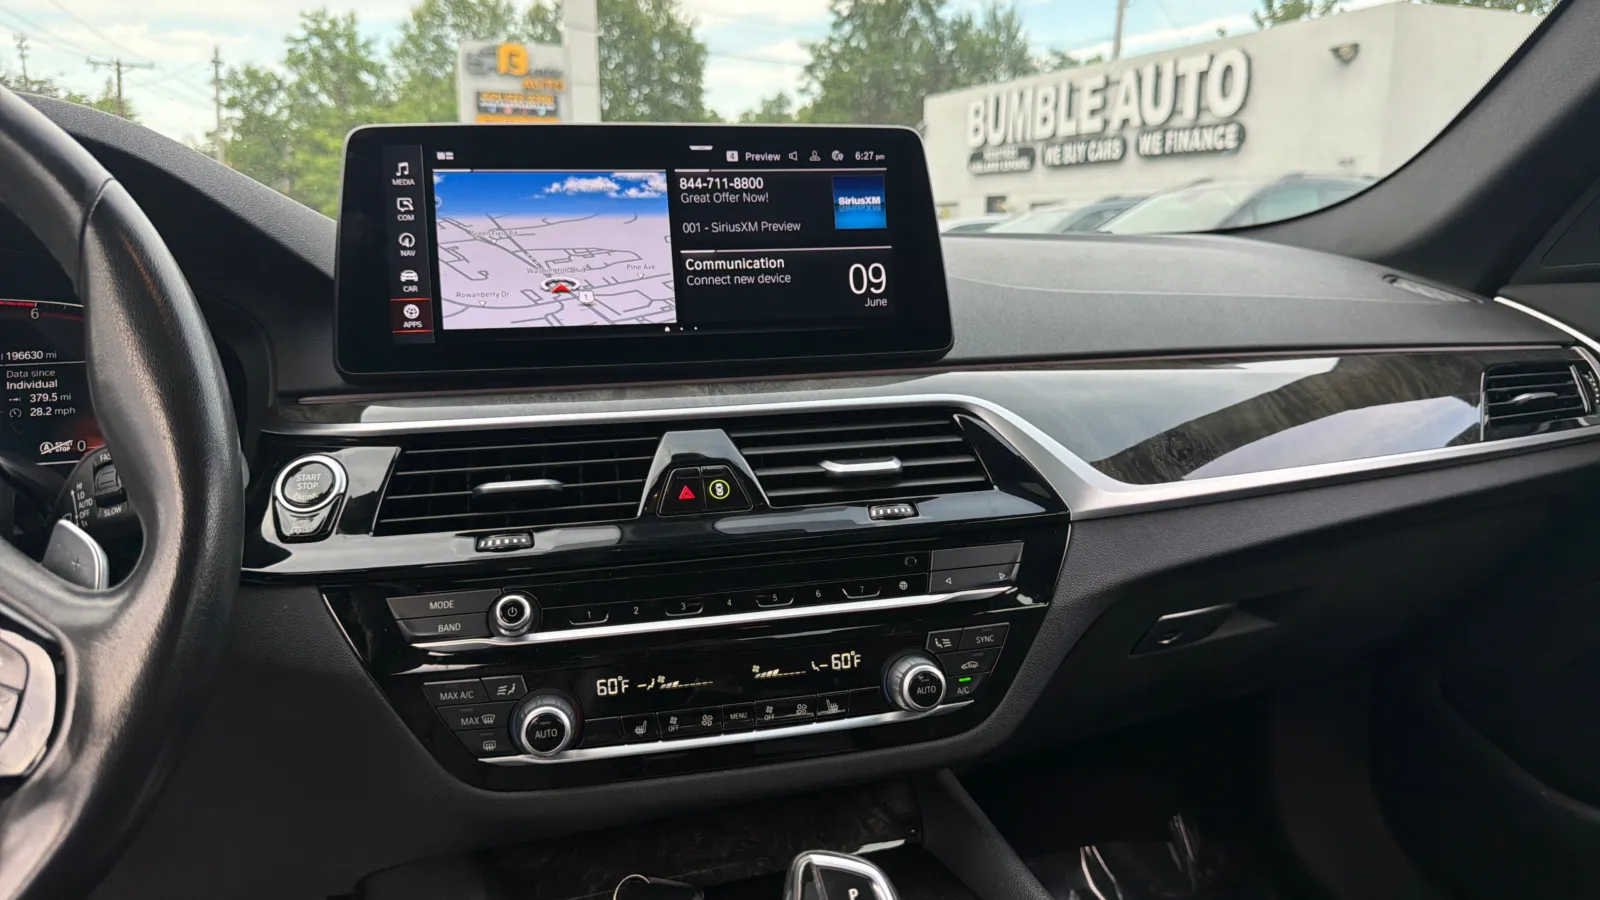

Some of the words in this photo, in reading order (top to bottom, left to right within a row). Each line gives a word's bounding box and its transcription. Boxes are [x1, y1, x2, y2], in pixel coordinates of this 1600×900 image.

[968, 77, 1106, 147] BUMBLE
[1111, 49, 1250, 130] AUTO
[1139, 132, 1162, 156] WE
[1164, 124, 1239, 152] FINANCE
[854, 152, 874, 161] 6:27
[1044, 145, 1061, 165] WE
[1063, 142, 1086, 163] BUY
[1087, 138, 1122, 161] CARS
[745, 152, 781, 162] Preview
[392, 178, 416, 186] MEDIA
[679, 177, 764, 190] 844-711-8800
[680, 192, 710, 204] Great
[713, 192, 740, 204] Offer
[742, 192, 770, 203] Now!
[838, 196, 882, 206] SiriusXM
[397, 214, 414, 222] COM
[682, 223, 701, 234] 001
[712, 222, 758, 232] SiriusXM
[760, 220, 801, 232] Preview
[400, 249, 416, 258] NAV
[685, 258, 785, 271] Communication
[526, 266, 567, 275] Washington
[686, 274, 732, 286] Connect
[734, 275, 755, 284] new
[758, 272, 792, 284] device
[848, 262, 887, 295] 09
[402, 285, 418, 293] CAR
[456, 290, 500, 300] Rowanberry
[864, 297, 888, 308] June
[30, 308, 40, 320] 6
[403, 320, 422, 329] APPS
[5, 350, 44, 361] 196630
[46, 351, 58, 359] mi
[6, 369, 28, 378] Data
[30, 368, 56, 378] since
[6, 380, 58, 390] Individual
[29, 393, 58, 403] 379.5
[60, 393, 72, 402] mi
[30, 406, 52, 417] 28.2
[54, 406, 76, 418] mph
[76, 440, 86, 452] 0
[100, 454, 112, 462] FAS
[296, 474, 322, 482] START
[78, 499, 93, 508] AUTO
[80, 510, 90, 518] OFF
[104, 506, 122, 517] SLOW
[816, 590, 822, 598] 6
[859, 586, 865, 594] 7
[726, 598, 732, 606] 4
[772, 594, 778, 602] 5
[429, 600, 454, 610] MODE
[634, 606, 638, 614] 2
[680, 602, 686, 610] 3
[438, 622, 462, 632] BAND
[976, 634, 994, 644] SYNC
[916, 684, 937, 696] AUTO
[956, 686, 970, 694] A/C
[440, 691, 458, 701] MAX
[460, 690, 475, 700] A/C
[460, 716, 480, 726] MAX
[730, 712, 748, 720] MENU
[668, 724, 680, 732] OFF
[535, 728, 558, 739] AUTO
[848, 888, 858, 900] P
